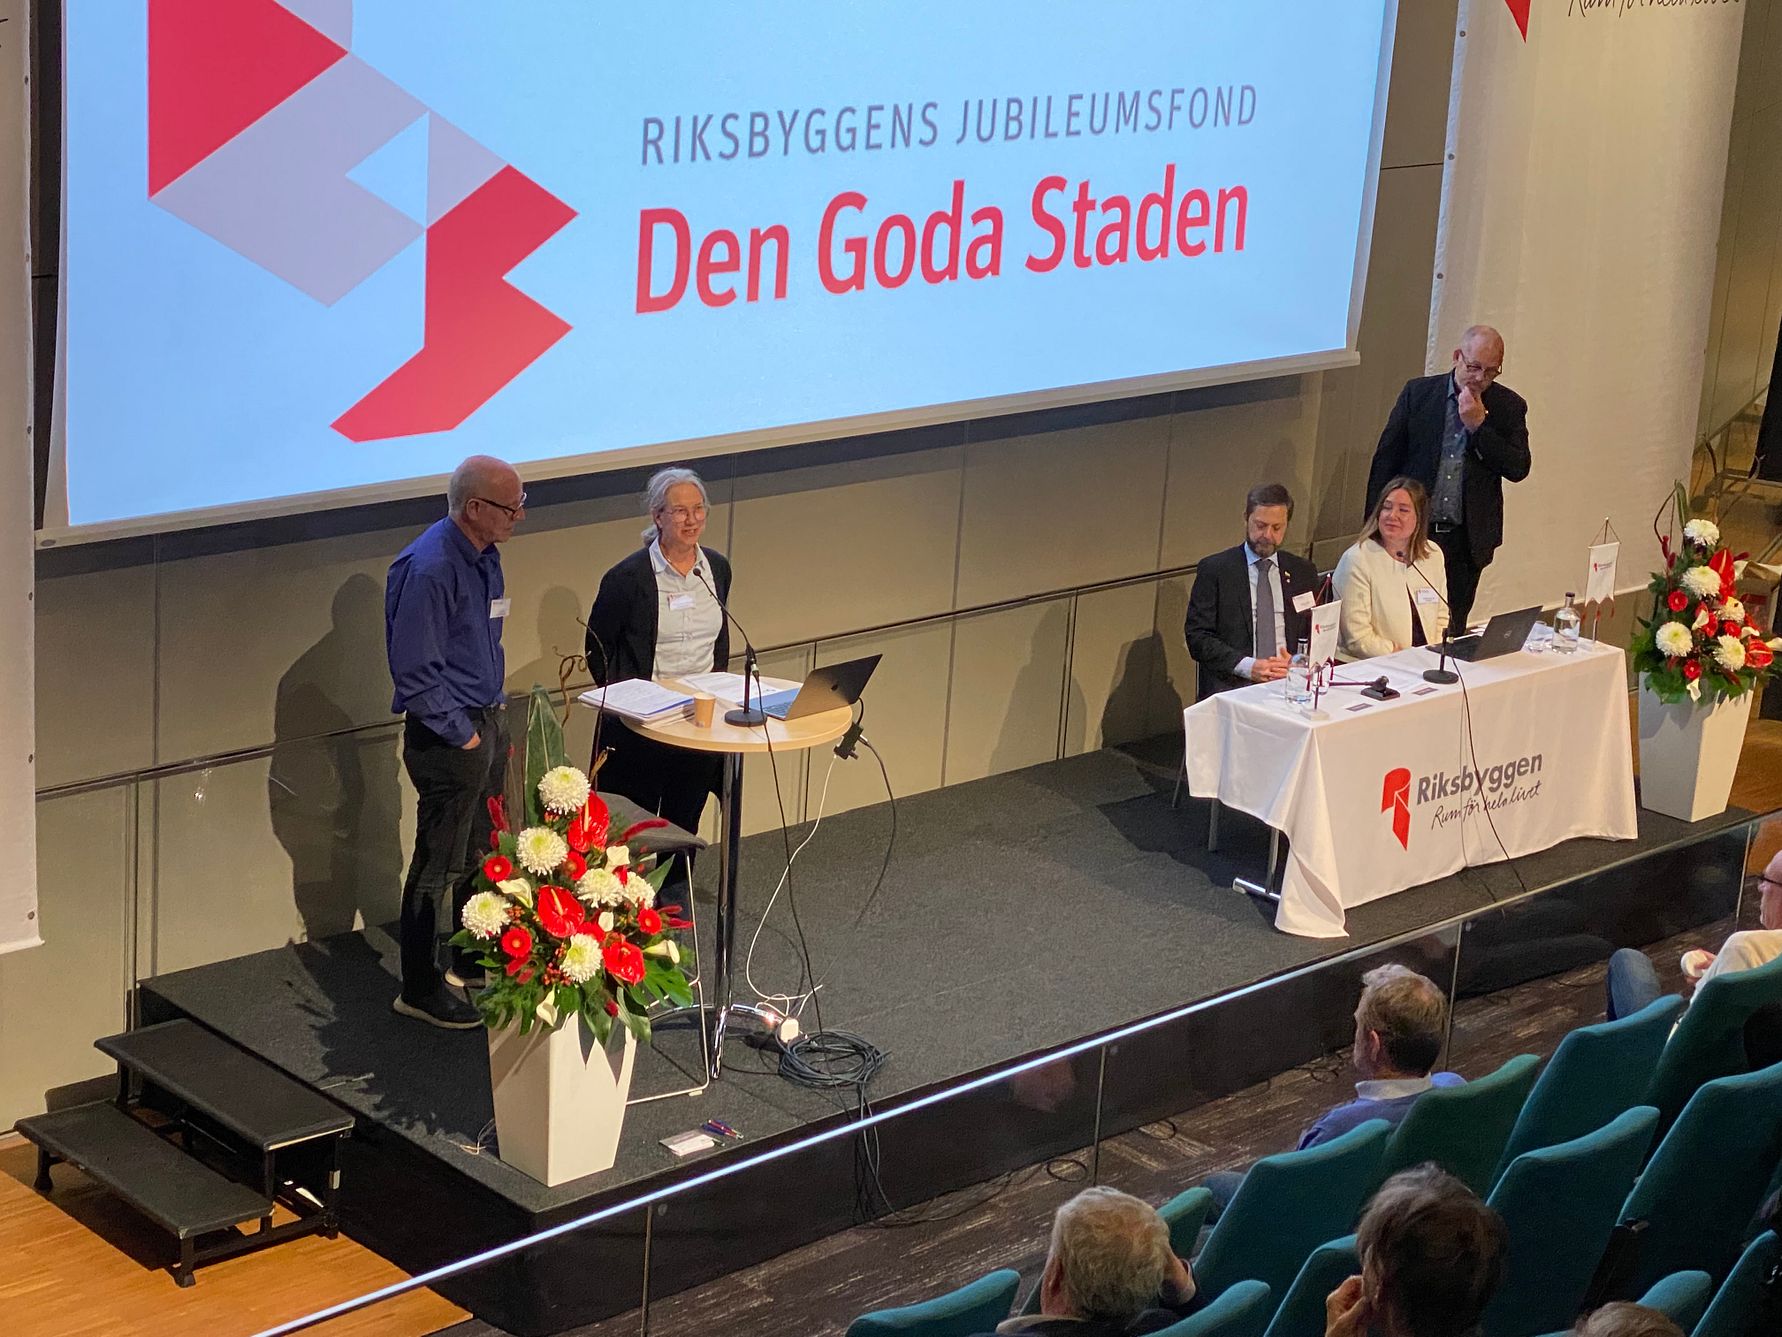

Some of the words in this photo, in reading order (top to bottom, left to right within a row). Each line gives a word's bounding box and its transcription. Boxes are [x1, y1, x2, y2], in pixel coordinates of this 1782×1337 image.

[641, 102, 939, 165] RIKSBYGGENS
[956, 84, 1257, 145] JUBILEUMSFOND
[636, 207, 790, 314] Den
[817, 179, 1005, 294] Goda
[1024, 163, 1248, 274] Staden
[1417, 753, 1542, 805] Riksbyggen
[1431, 805, 1462, 830] Rum
[1463, 797, 1480, 822] för
[1509, 780, 1542, 803] livet
